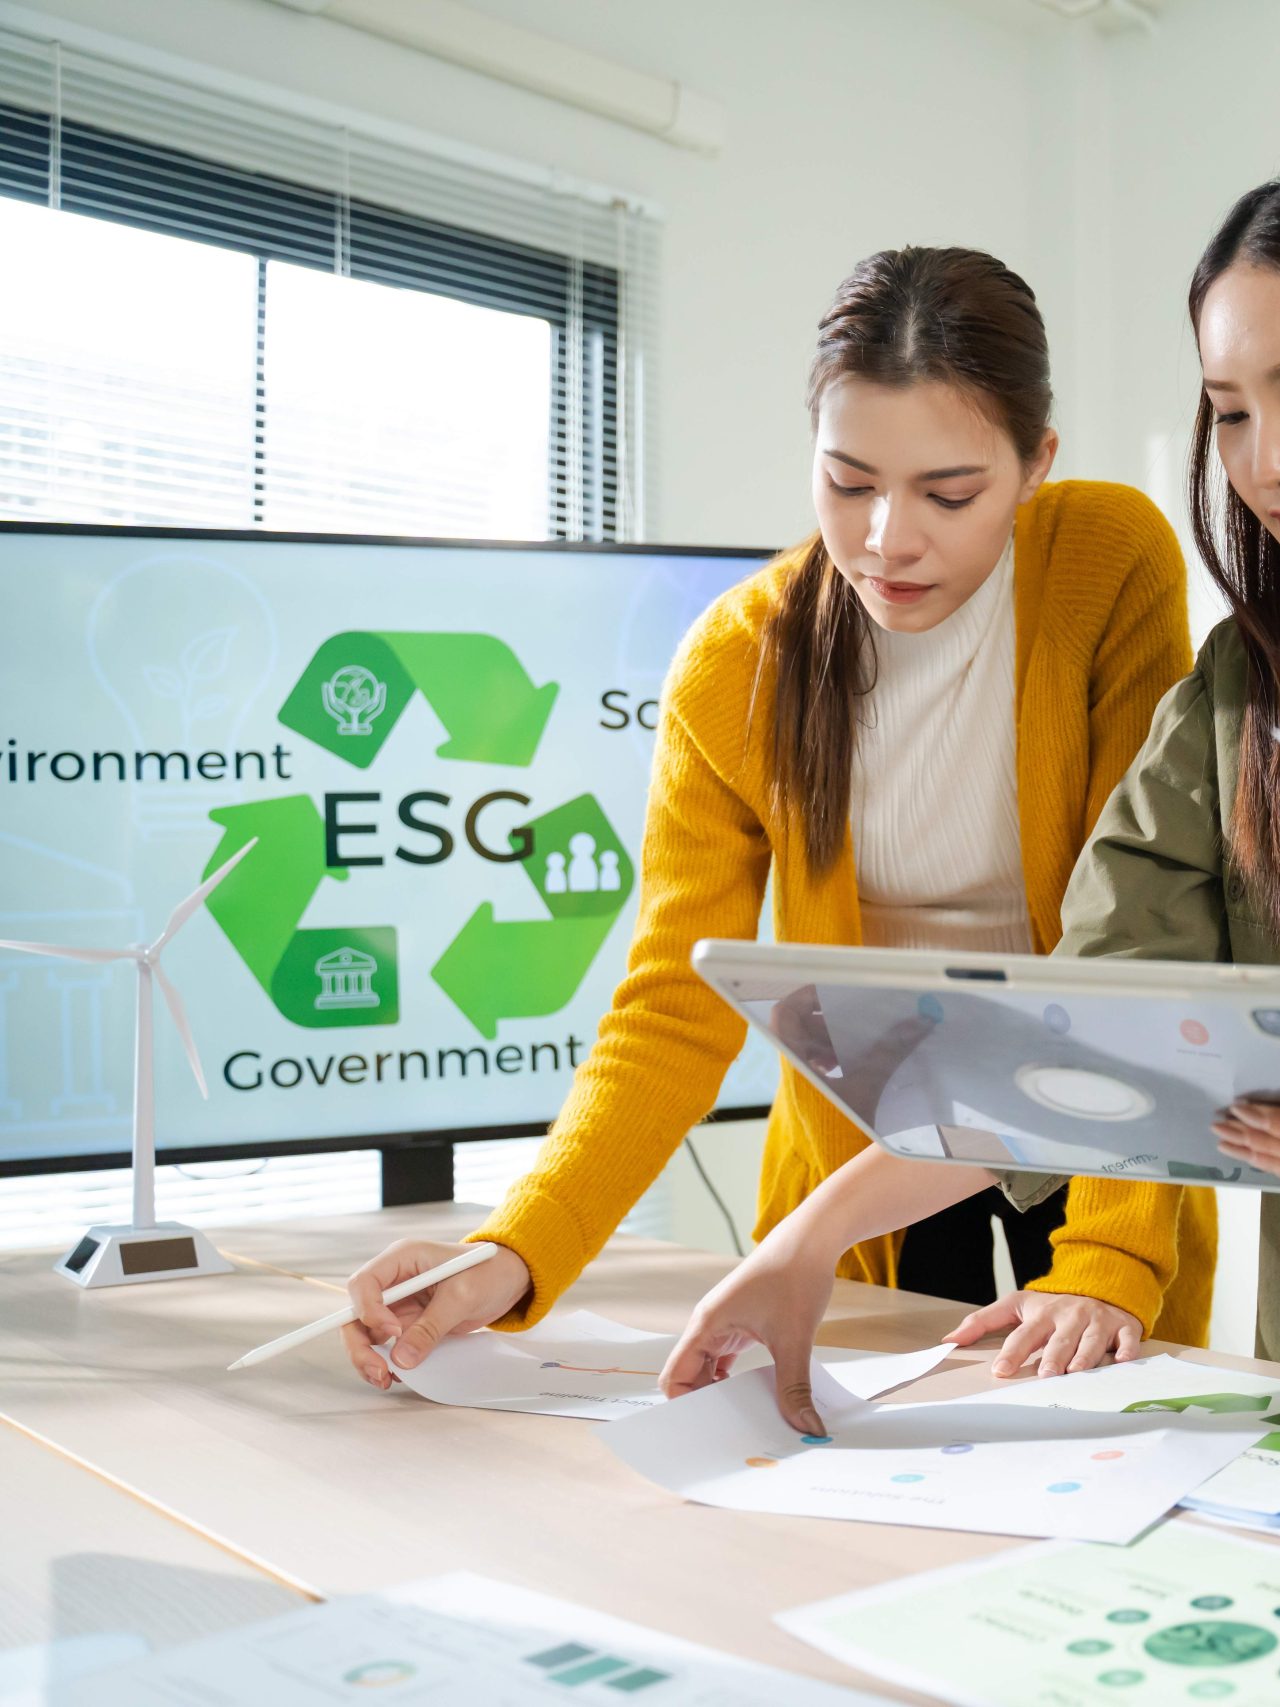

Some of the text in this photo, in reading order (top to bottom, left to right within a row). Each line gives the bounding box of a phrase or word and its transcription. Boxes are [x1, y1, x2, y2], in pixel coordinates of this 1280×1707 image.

[0, 738, 292, 782] ironment
[323, 790, 537, 868] ESG
[223, 1034, 583, 1091] Government
